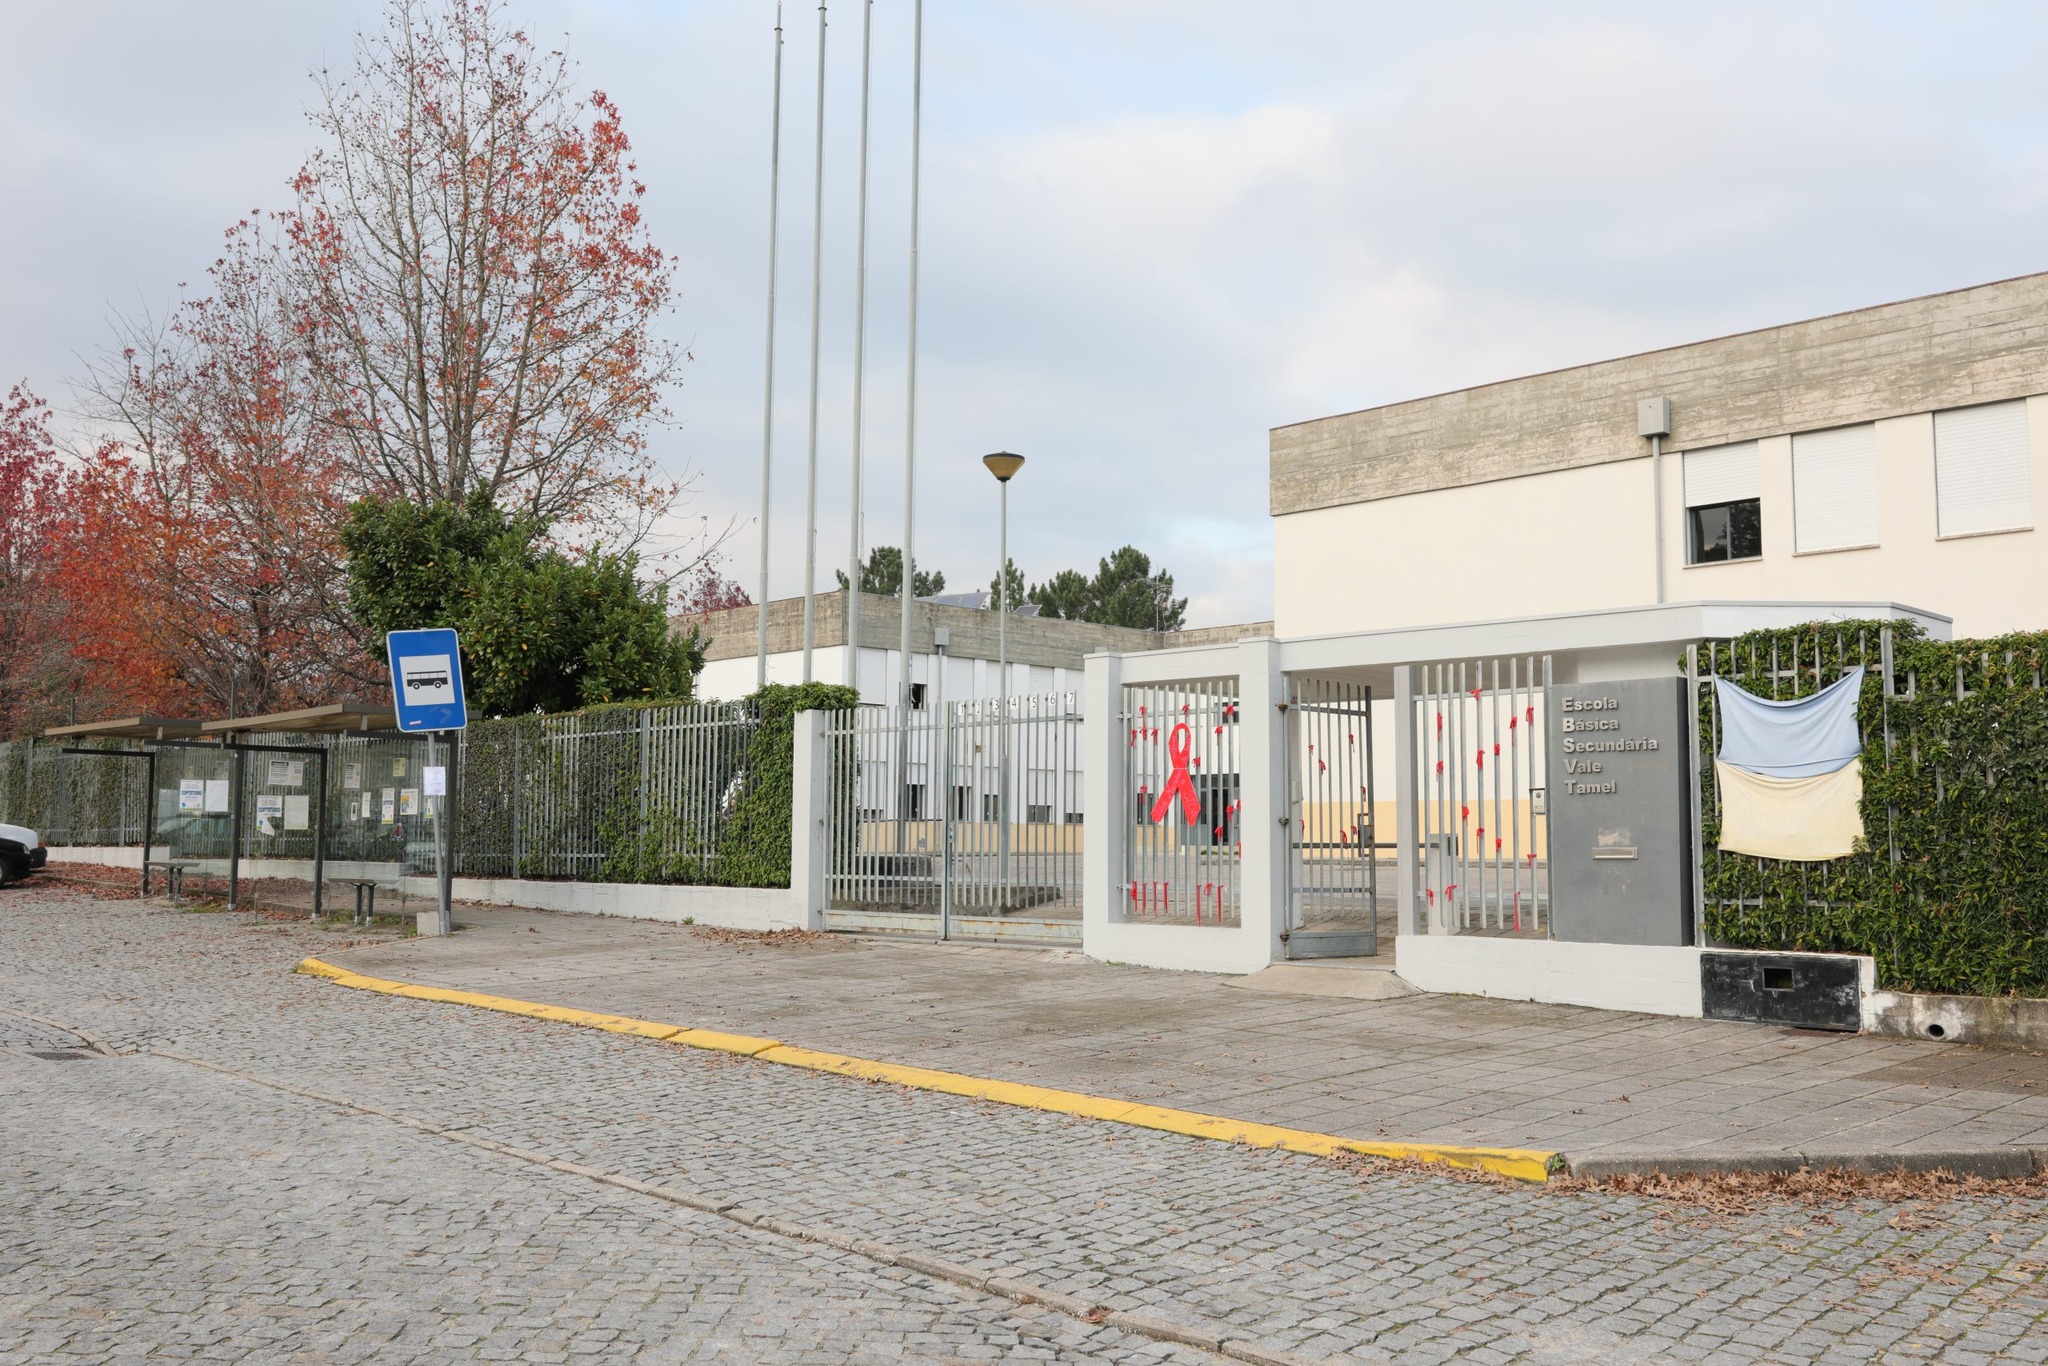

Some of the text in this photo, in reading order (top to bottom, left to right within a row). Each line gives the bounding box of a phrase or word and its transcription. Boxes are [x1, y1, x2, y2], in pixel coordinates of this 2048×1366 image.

[1011, 698, 1017, 707] 4
[1032, 697, 1037, 708] 5
[1050, 694, 1055, 704] 6
[1069, 693, 1074, 703] 7
[976, 703, 981, 714] 2
[994, 699, 1000, 710] 3
[1562, 697, 1618, 711] Escola
[1562, 717, 1619, 732] Básica
[1562, 737, 1658, 753] Secundária
[1563, 759, 1602, 774] Vale
[1564, 780, 1616, 794] Tamel
